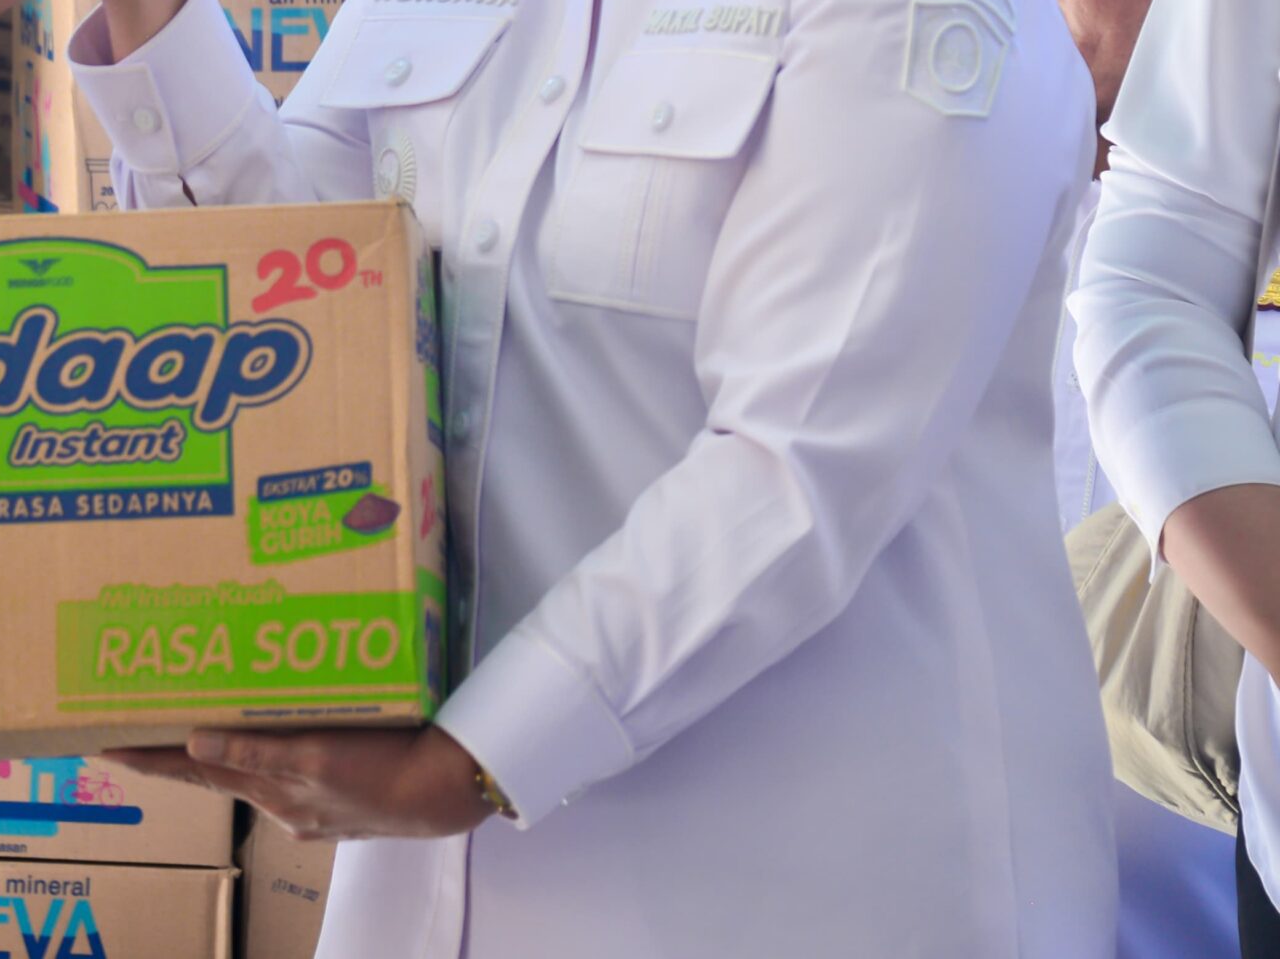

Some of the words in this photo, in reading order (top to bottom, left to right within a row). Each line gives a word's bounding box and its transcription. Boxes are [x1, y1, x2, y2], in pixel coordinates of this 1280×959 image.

[9, 420, 183, 467] Instant
[75, 489, 213, 516] SEDAPNYA
[261, 500, 331, 529] KOYA
[95, 621, 234, 680] RASA
[250, 617, 401, 674] SOTO
[6, 876, 91, 897] mineral
